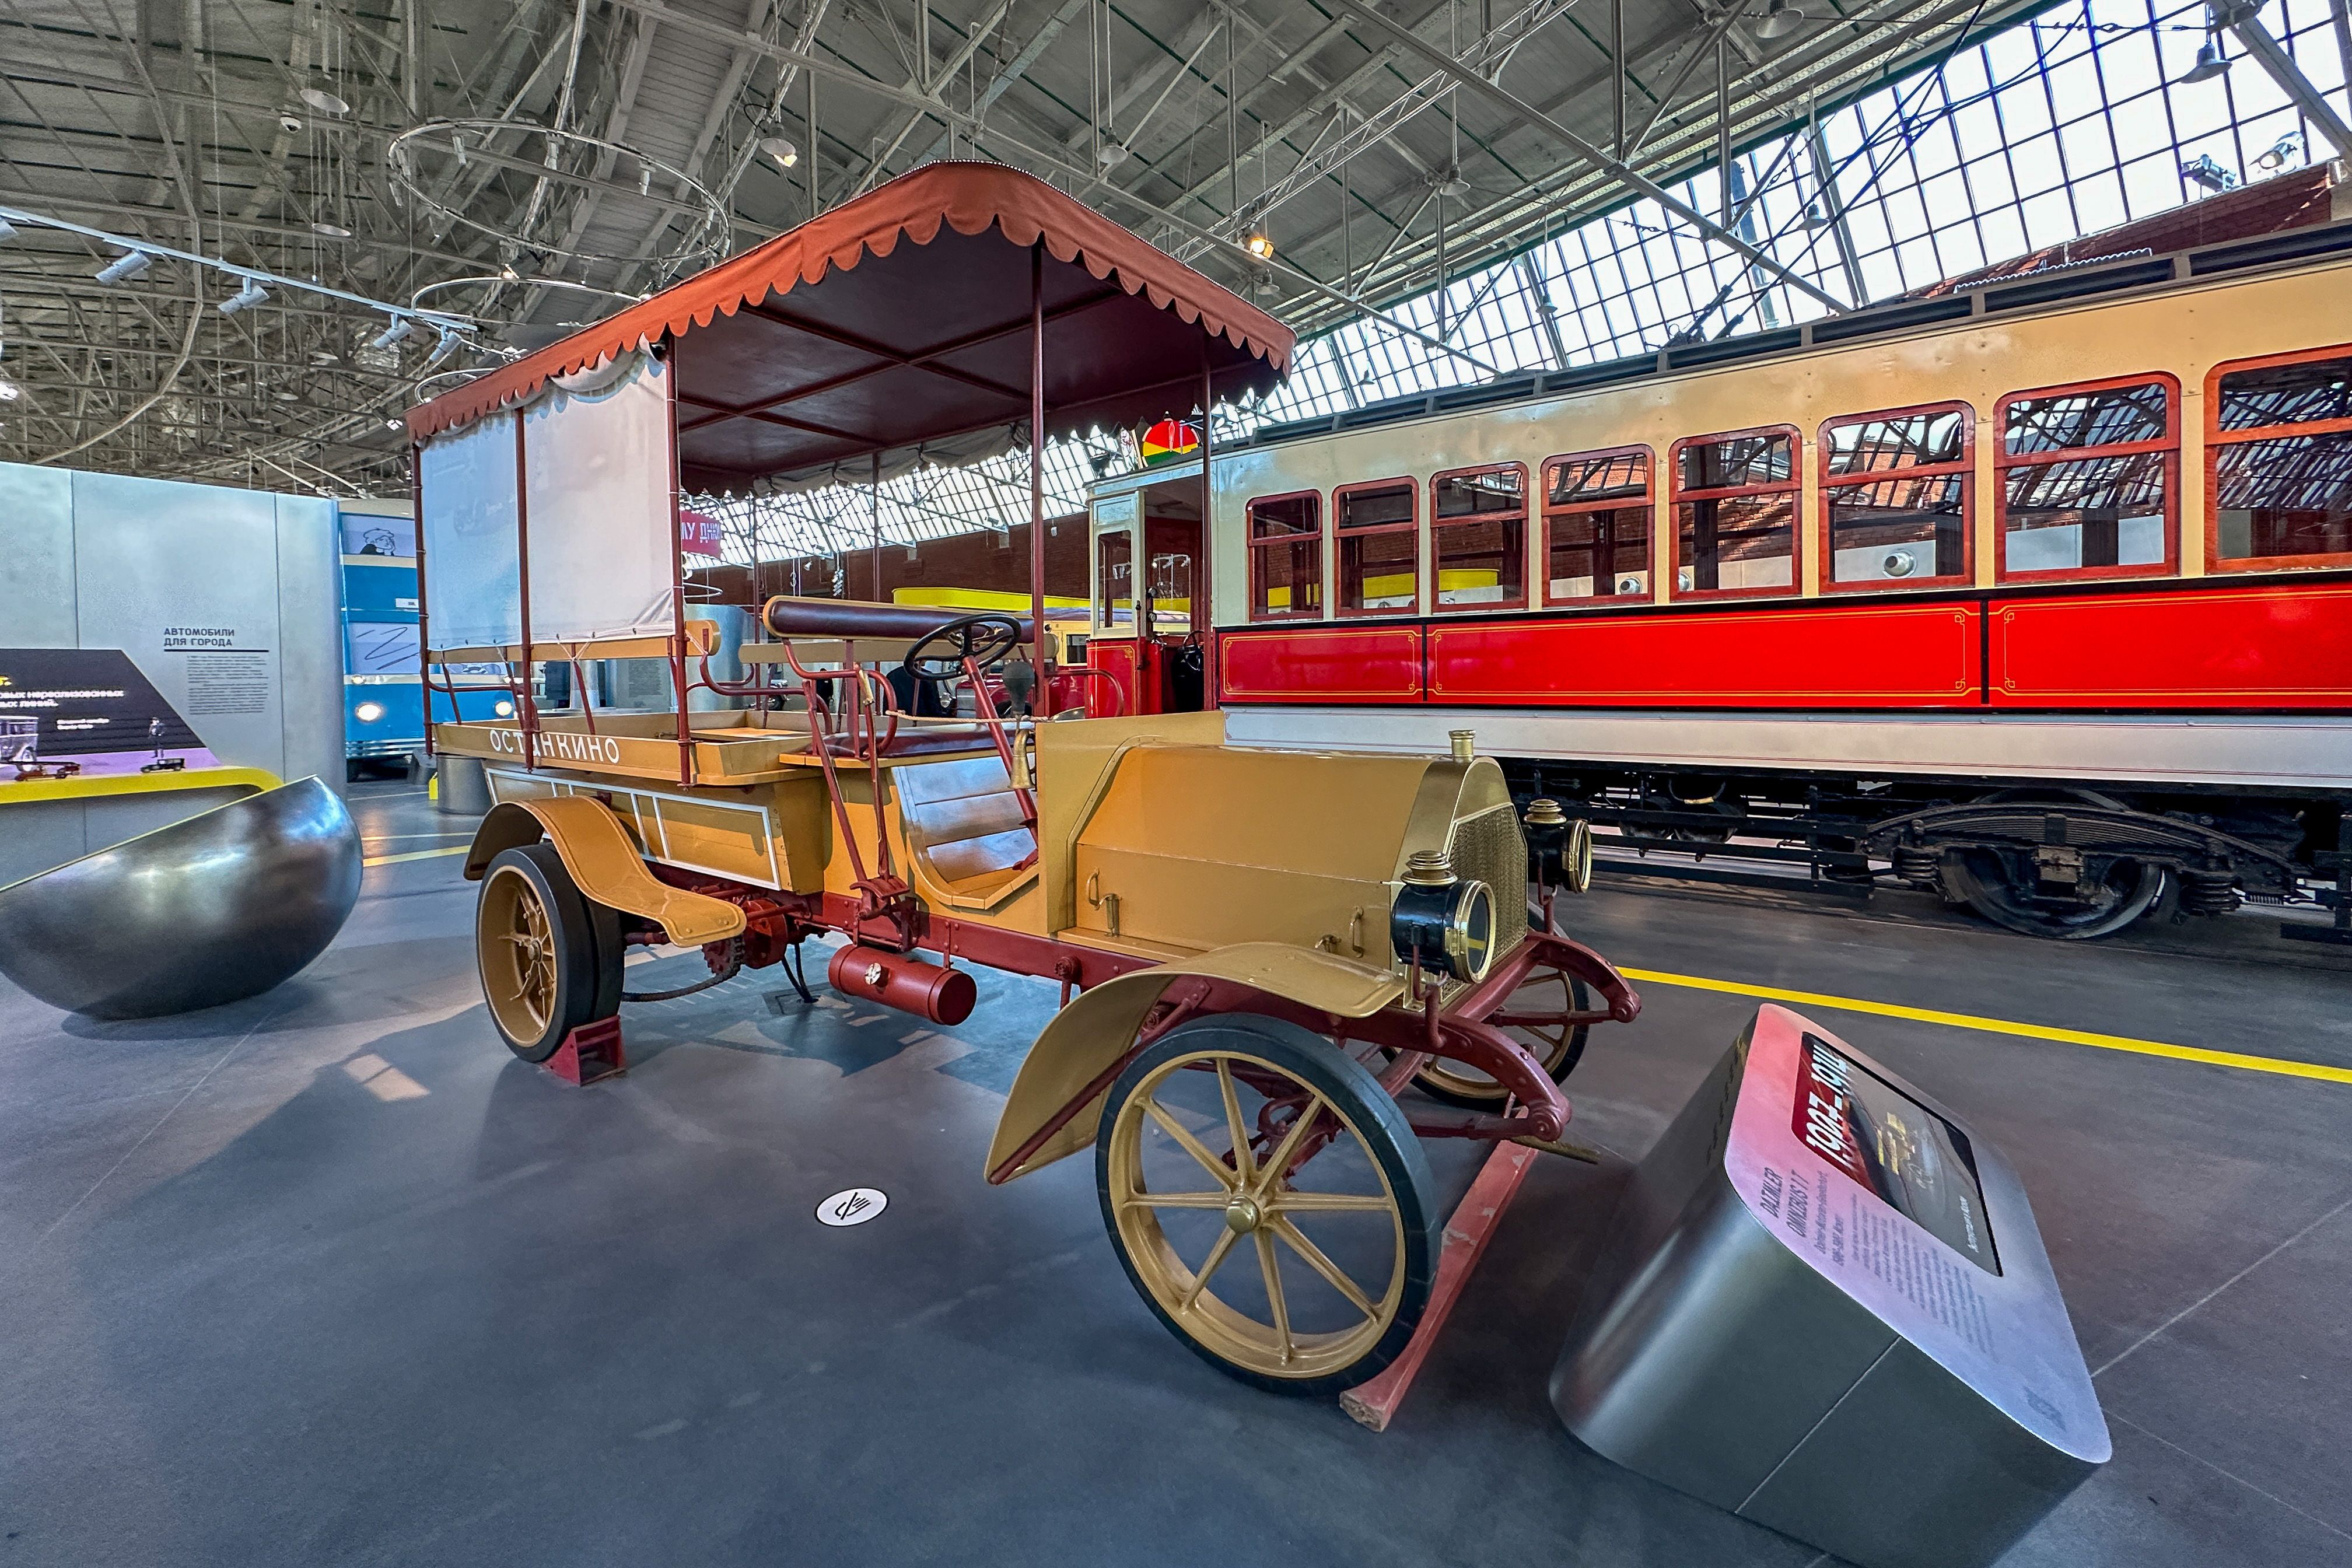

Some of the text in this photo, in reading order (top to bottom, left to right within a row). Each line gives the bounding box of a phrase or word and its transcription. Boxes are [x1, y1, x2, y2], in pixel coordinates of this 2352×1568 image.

[163, 628, 235, 636] АВТОМОБИЛИ
[164, 638, 232, 647] ДЛЯ ГОРОДА
[1760, 1167, 1783, 1219] DAIMLER
[1786, 1184, 1808, 1238] OMNIBUS
